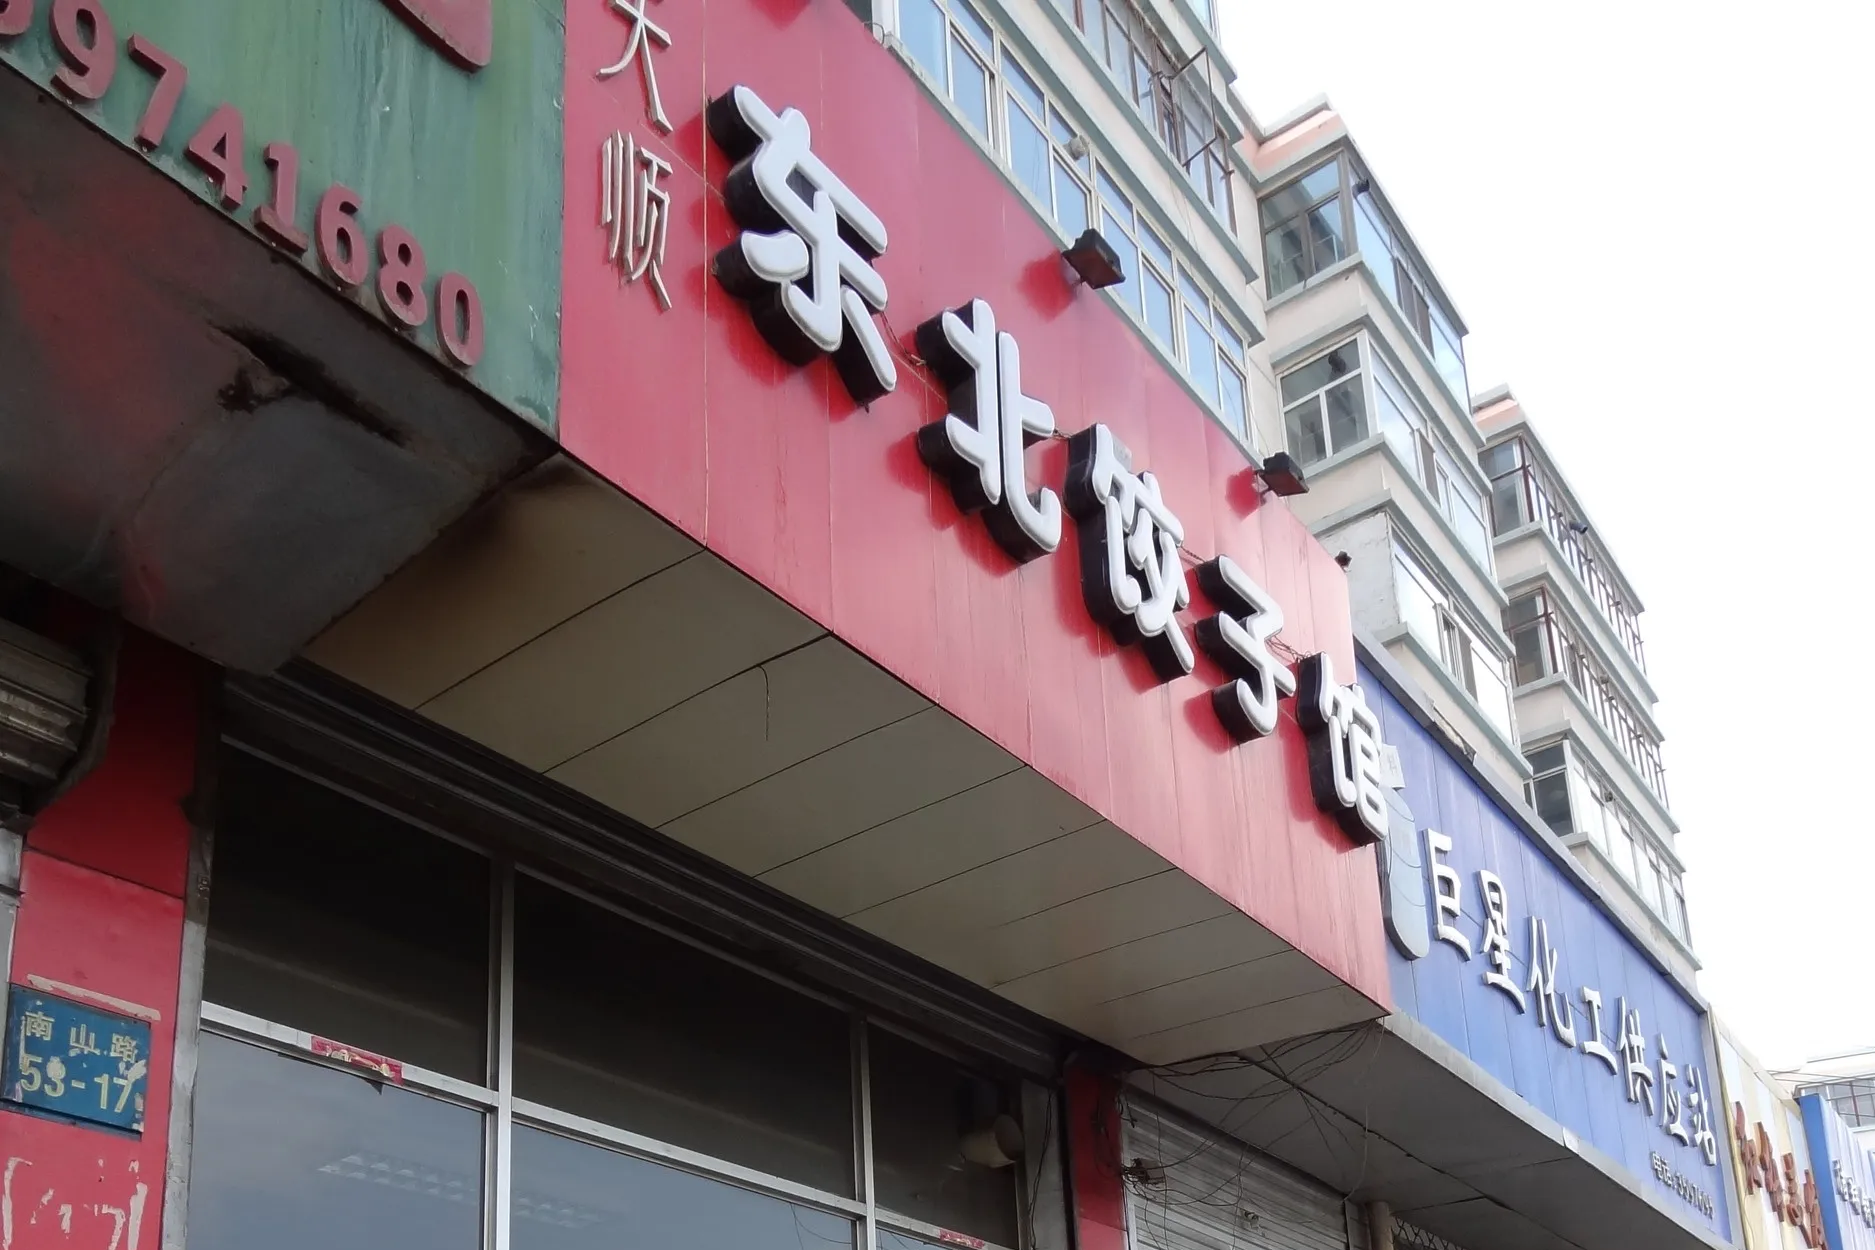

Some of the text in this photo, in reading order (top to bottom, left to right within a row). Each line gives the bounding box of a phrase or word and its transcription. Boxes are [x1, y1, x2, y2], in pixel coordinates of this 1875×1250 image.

[706, 84, 1389, 848] 东北饺子馆
[20, 1053, 135, 1113] 53-17
[24, 1011, 138, 1063] 南山路
[1424, 828, 1717, 1167] 巨星化工供应站
